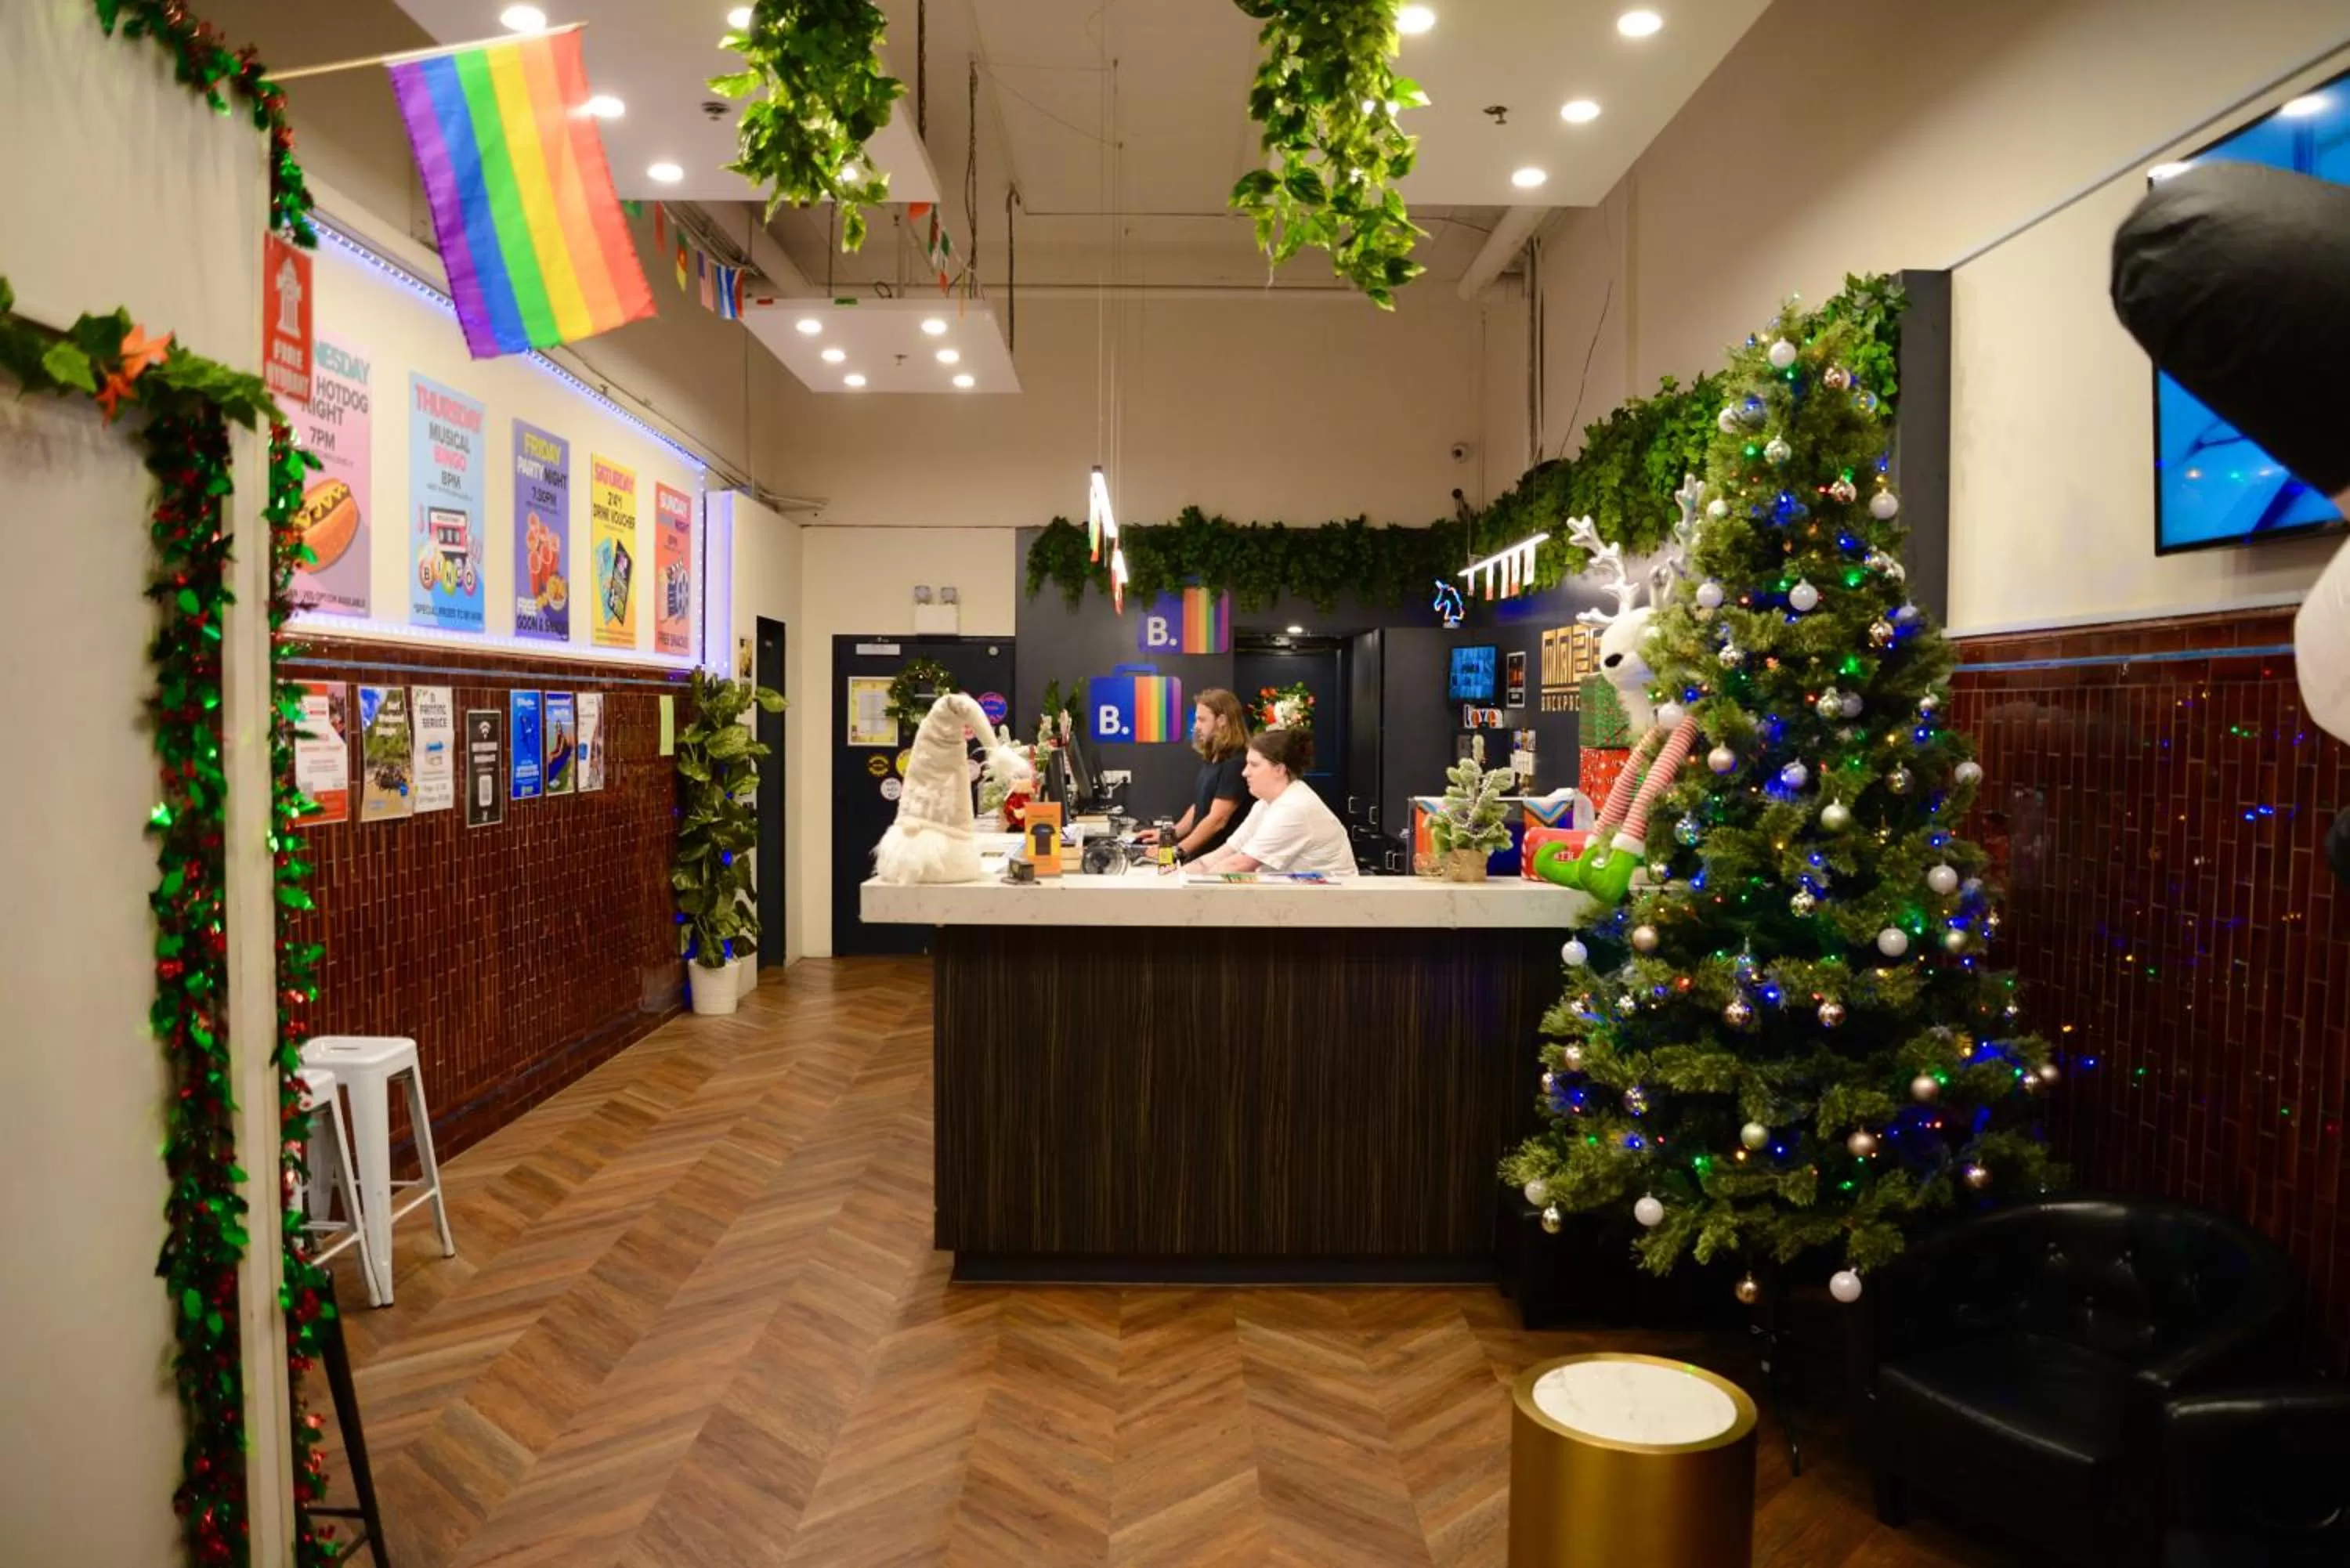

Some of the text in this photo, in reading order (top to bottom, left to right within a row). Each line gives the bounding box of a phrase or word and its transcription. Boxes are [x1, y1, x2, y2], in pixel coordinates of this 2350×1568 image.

[273, 338, 303, 370] FIRE
[313, 340, 371, 385] NESDAY
[316, 376, 368, 414] HOTDOG
[416, 382, 483, 434] THURSDAY
[309, 426, 335, 450] 7PM
[429, 421, 471, 454] MUSICAL
[525, 432, 561, 466] FRIDAY
[517, 456, 566, 490] PARTY NIGHT
[611, 510, 634, 529] VOUCHER
[517, 596, 537, 616] FREE
[1147, 616, 1177, 646] B.
[1542, 694, 1580, 712] BACKPAC
[1099, 705, 1130, 735] B.
